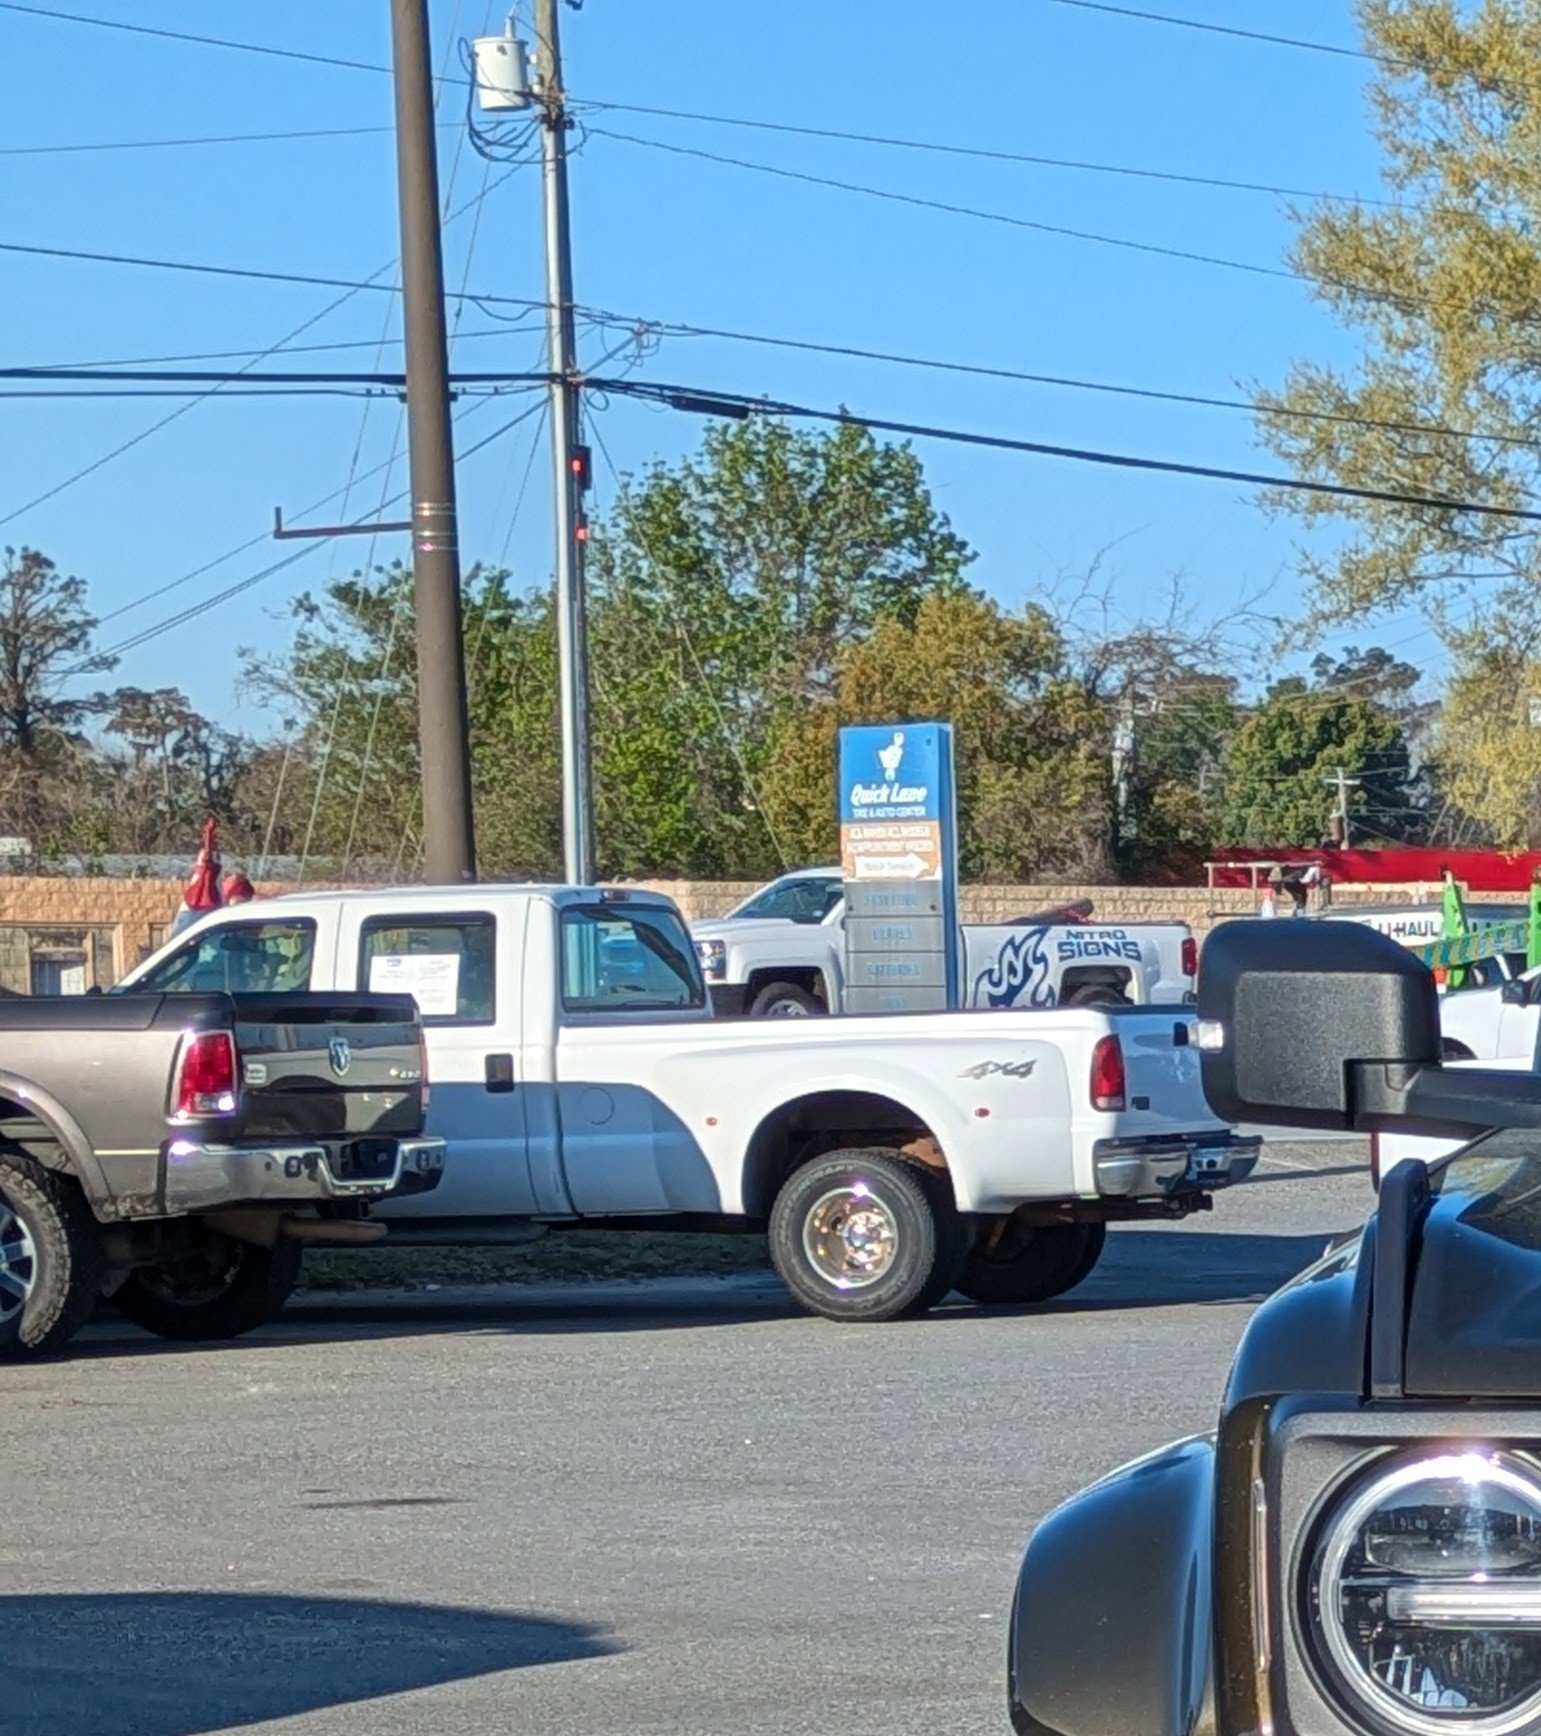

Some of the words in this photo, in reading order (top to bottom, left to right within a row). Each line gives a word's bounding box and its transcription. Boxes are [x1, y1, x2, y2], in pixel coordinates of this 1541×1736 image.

[850, 783, 890, 806] Quick
[890, 782, 927, 803] Lane
[1066, 929, 1128, 940] NITRO
[1379, 920, 1440, 937] U-HAUL
[1057, 941, 1142, 962] SIGNS
